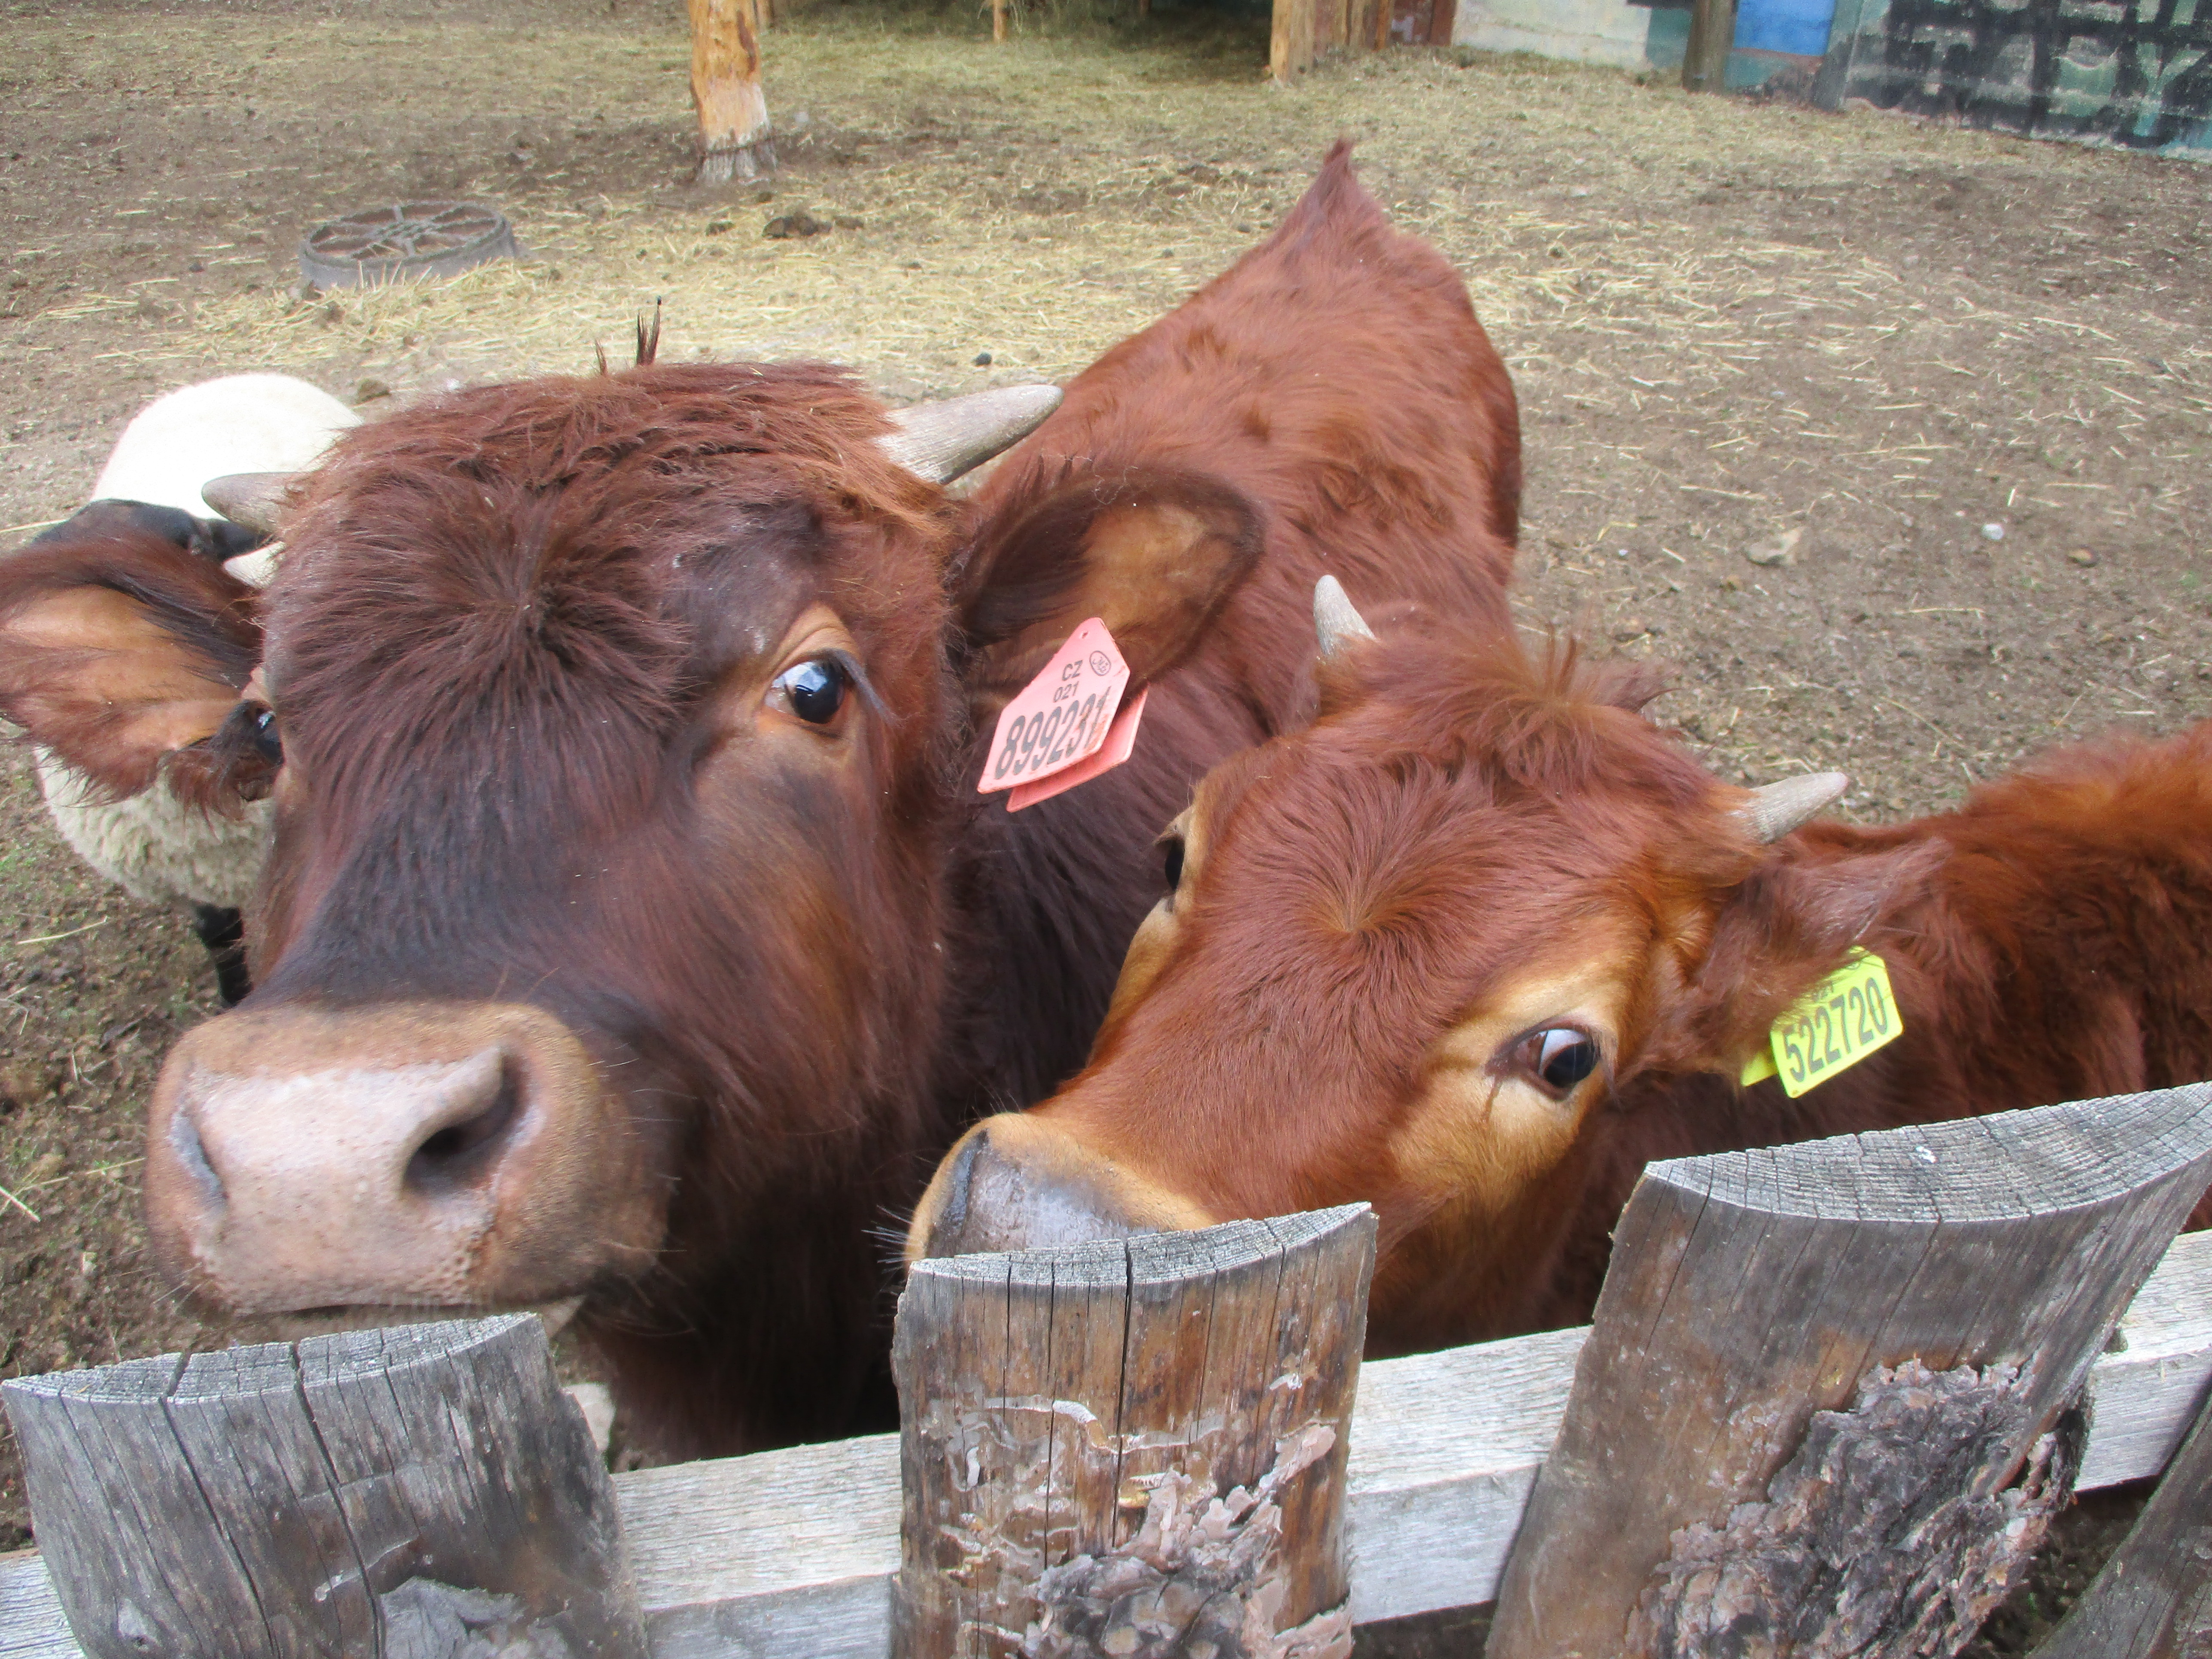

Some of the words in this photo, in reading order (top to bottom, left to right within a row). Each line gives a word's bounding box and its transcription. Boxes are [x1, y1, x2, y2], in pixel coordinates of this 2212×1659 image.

[1053, 681, 1079, 703] 021
[1062, 660, 1083, 681] CZ
[995, 686, 1112, 780] 899231
[1783, 978, 1888, 1082] 522720
